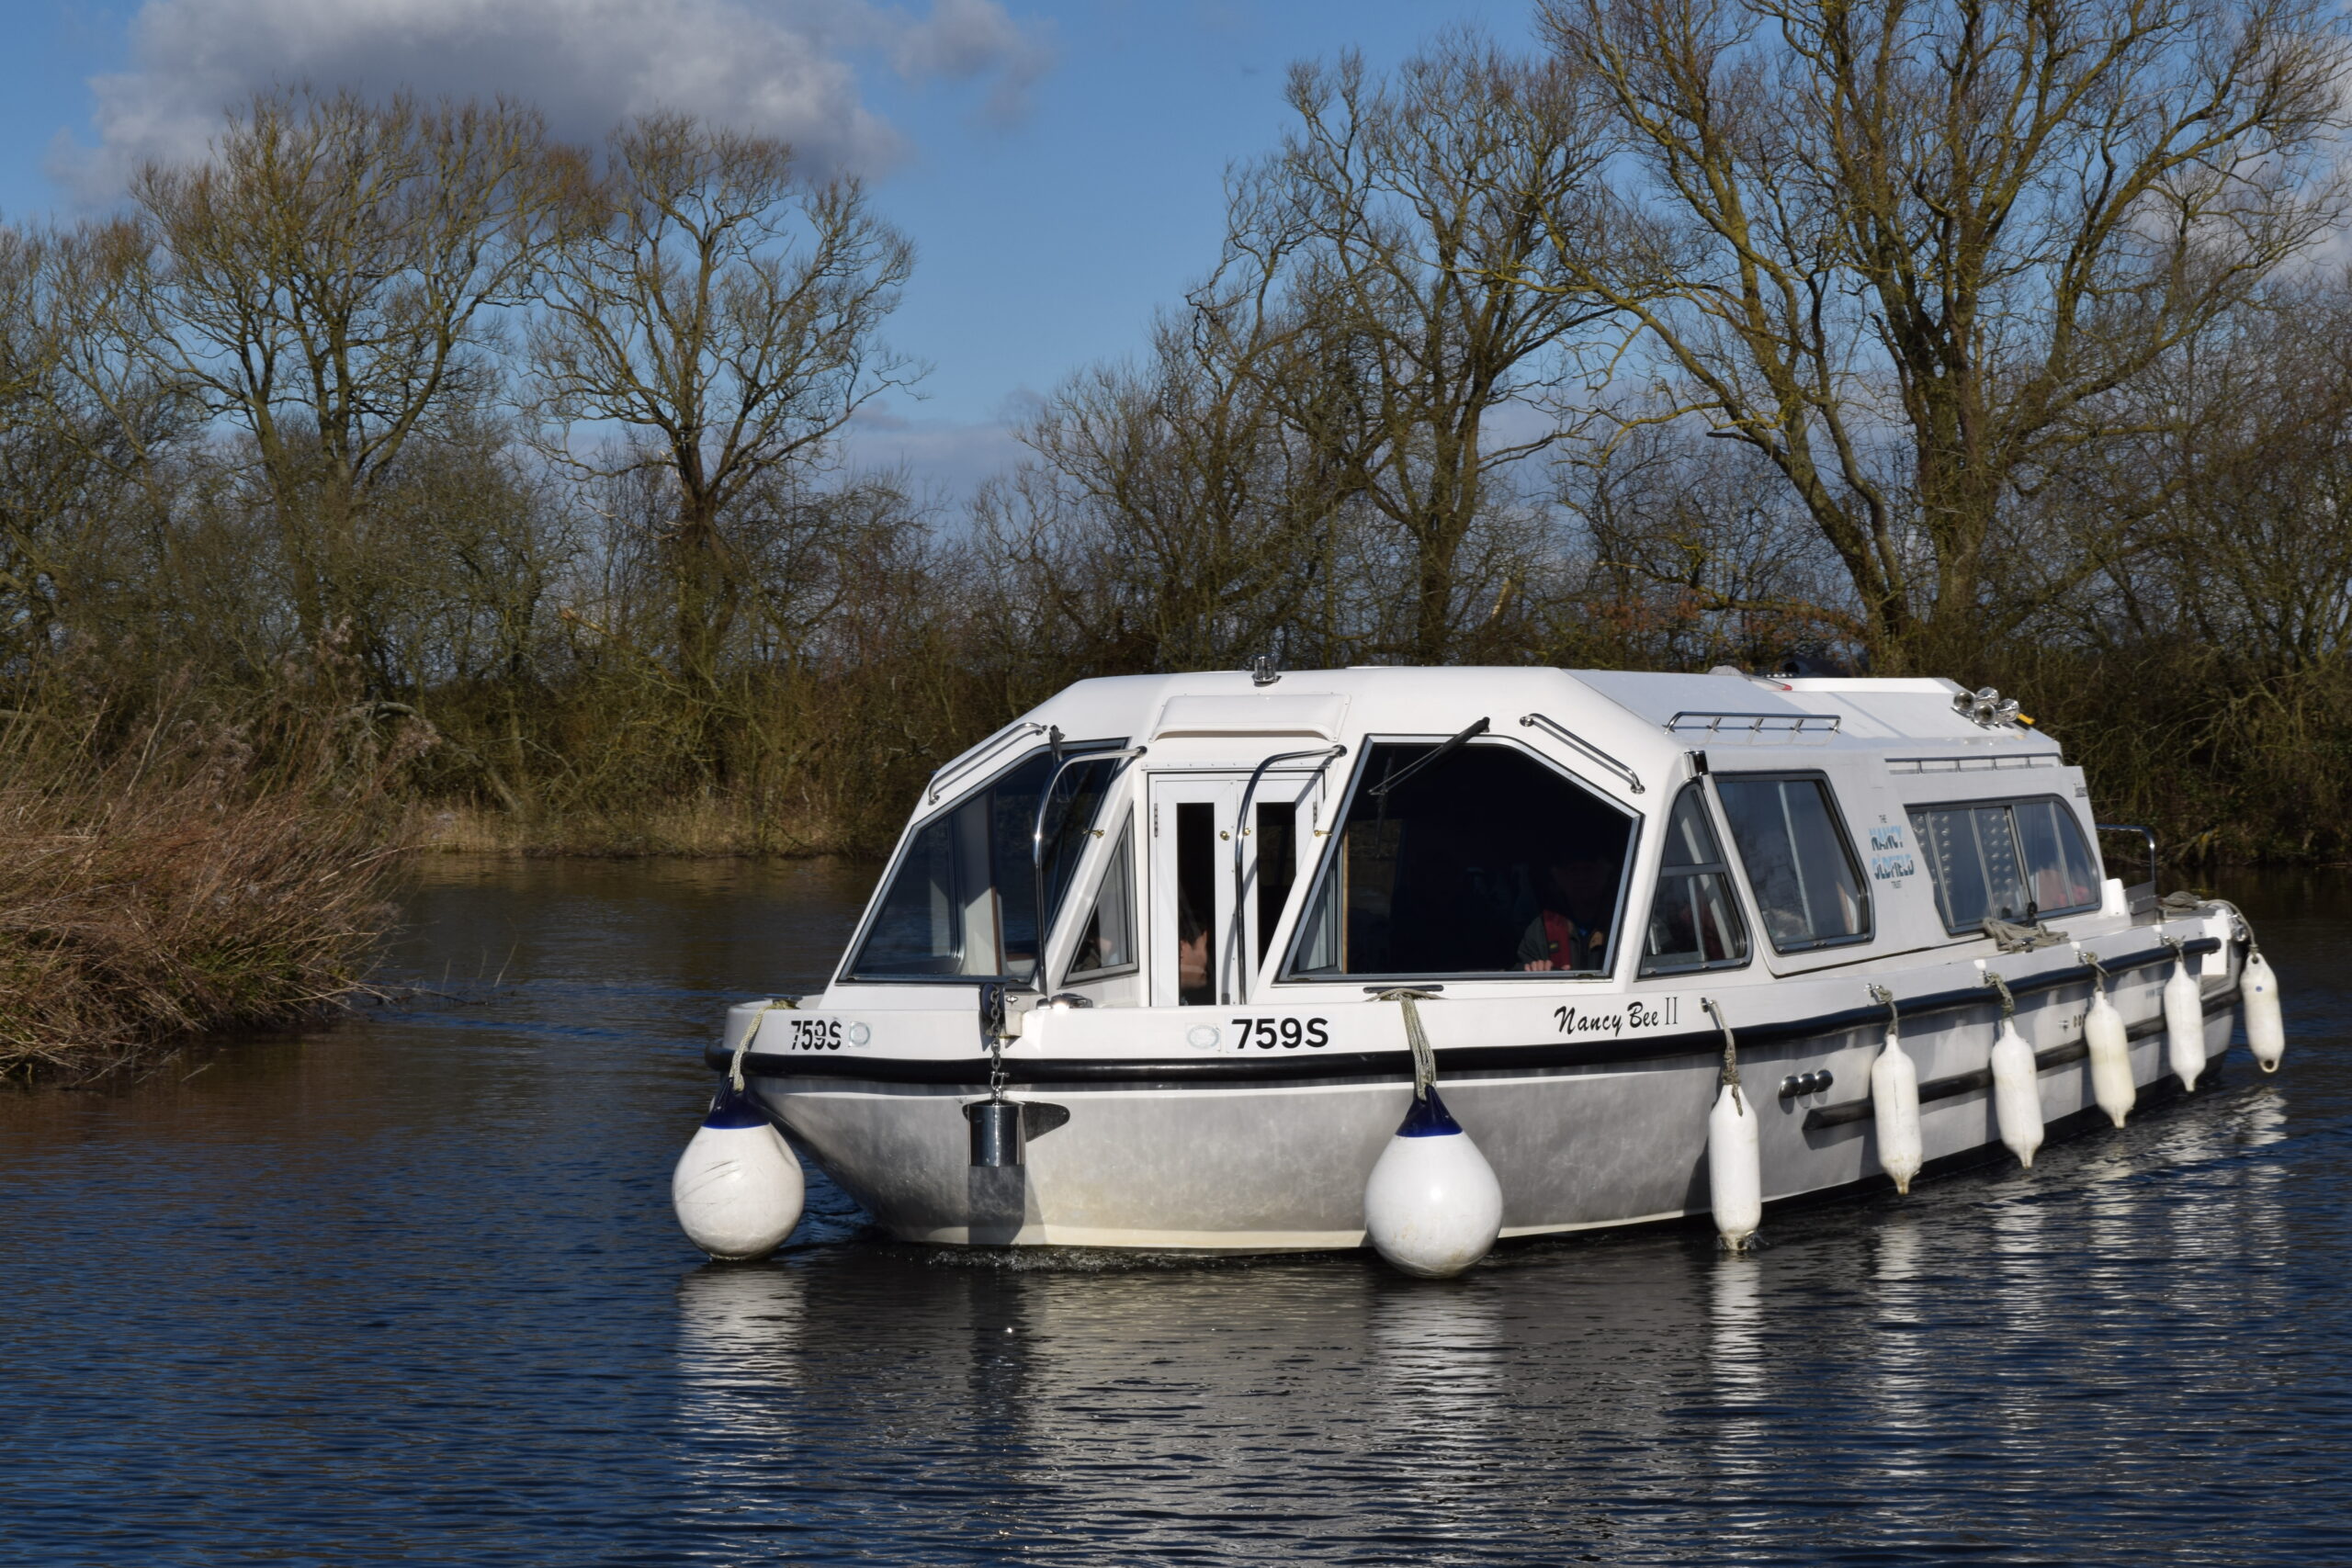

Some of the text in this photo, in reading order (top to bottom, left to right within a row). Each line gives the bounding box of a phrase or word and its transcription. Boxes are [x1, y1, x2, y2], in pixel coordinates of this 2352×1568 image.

[1869, 825, 1904, 852] NANCY
[1871, 854, 1915, 880] OLDFIELD
[1231, 1017, 1329, 1049] 759S
[1554, 1005, 1623, 1037] Nancy
[1626, 1000, 1658, 1029] Bee
[791, 1020, 842, 1051] 759S
